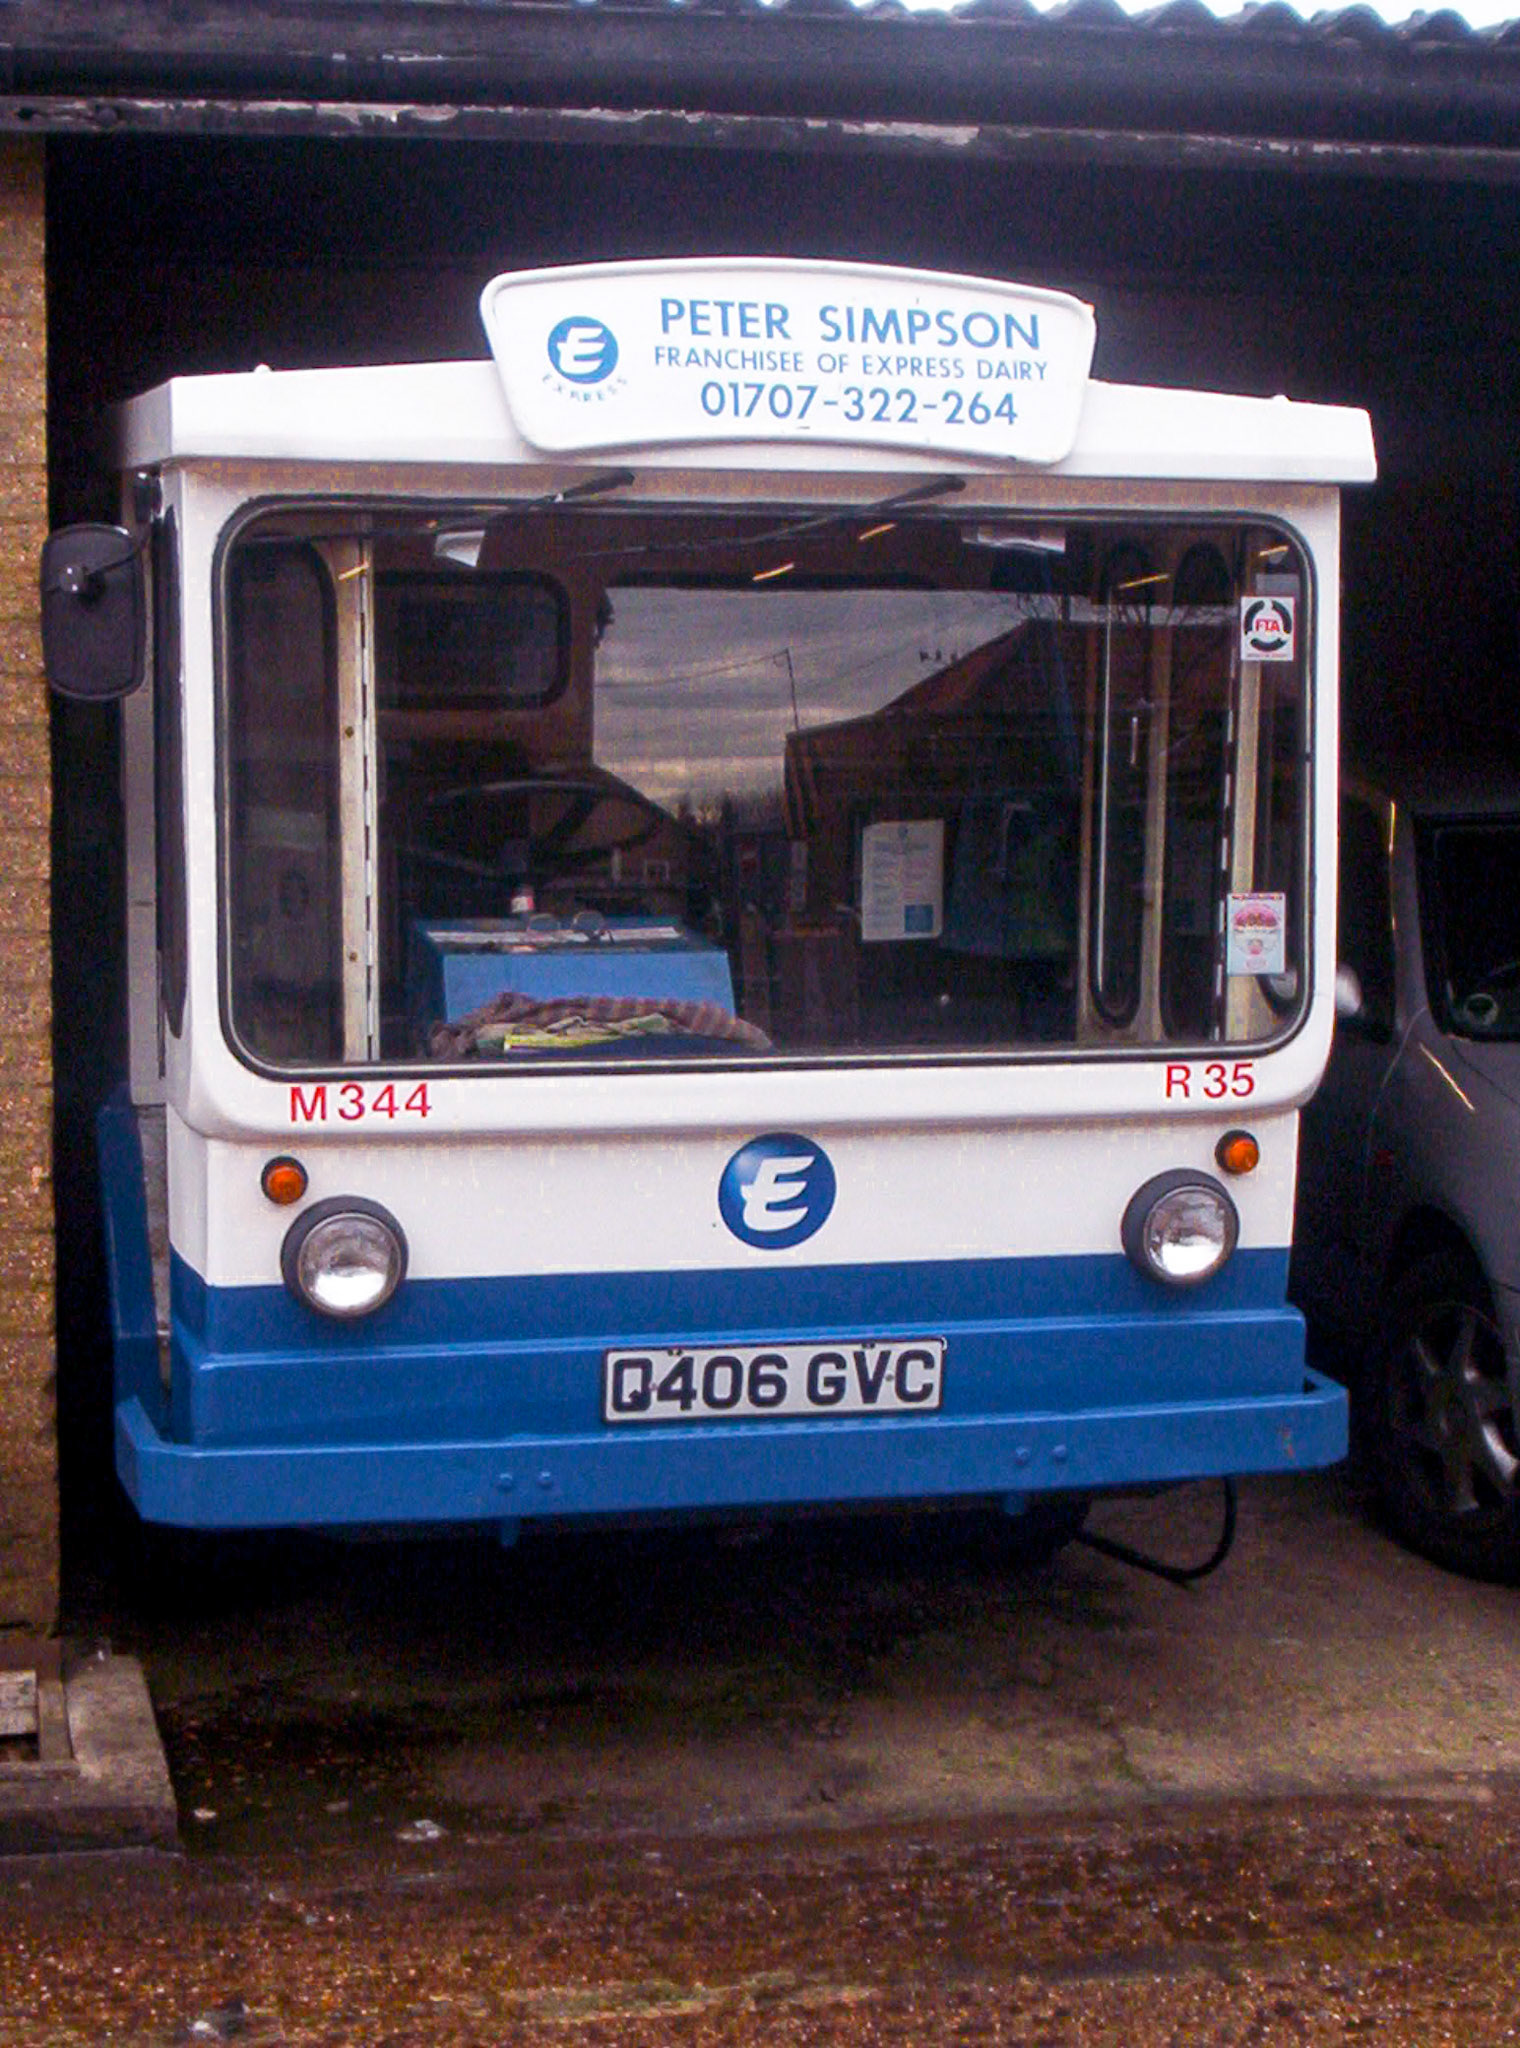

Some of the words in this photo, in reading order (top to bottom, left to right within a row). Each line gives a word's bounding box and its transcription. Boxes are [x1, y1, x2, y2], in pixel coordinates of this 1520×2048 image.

[660, 298, 792, 340] PETER
[818, 304, 1041, 351] SIMPSON
[654, 345, 804, 373] FRANCHISEE
[817, 352, 849, 375] OF
[862, 353, 966, 379] EXPRESS
[976, 357, 1048, 381] DAIRY
[700, 380, 1019, 426] 01707-322-264
[1254, 618, 1281, 633] FTA
[611, 1353, 789, 1414] Q406
[805, 1348, 936, 1407] GVC
